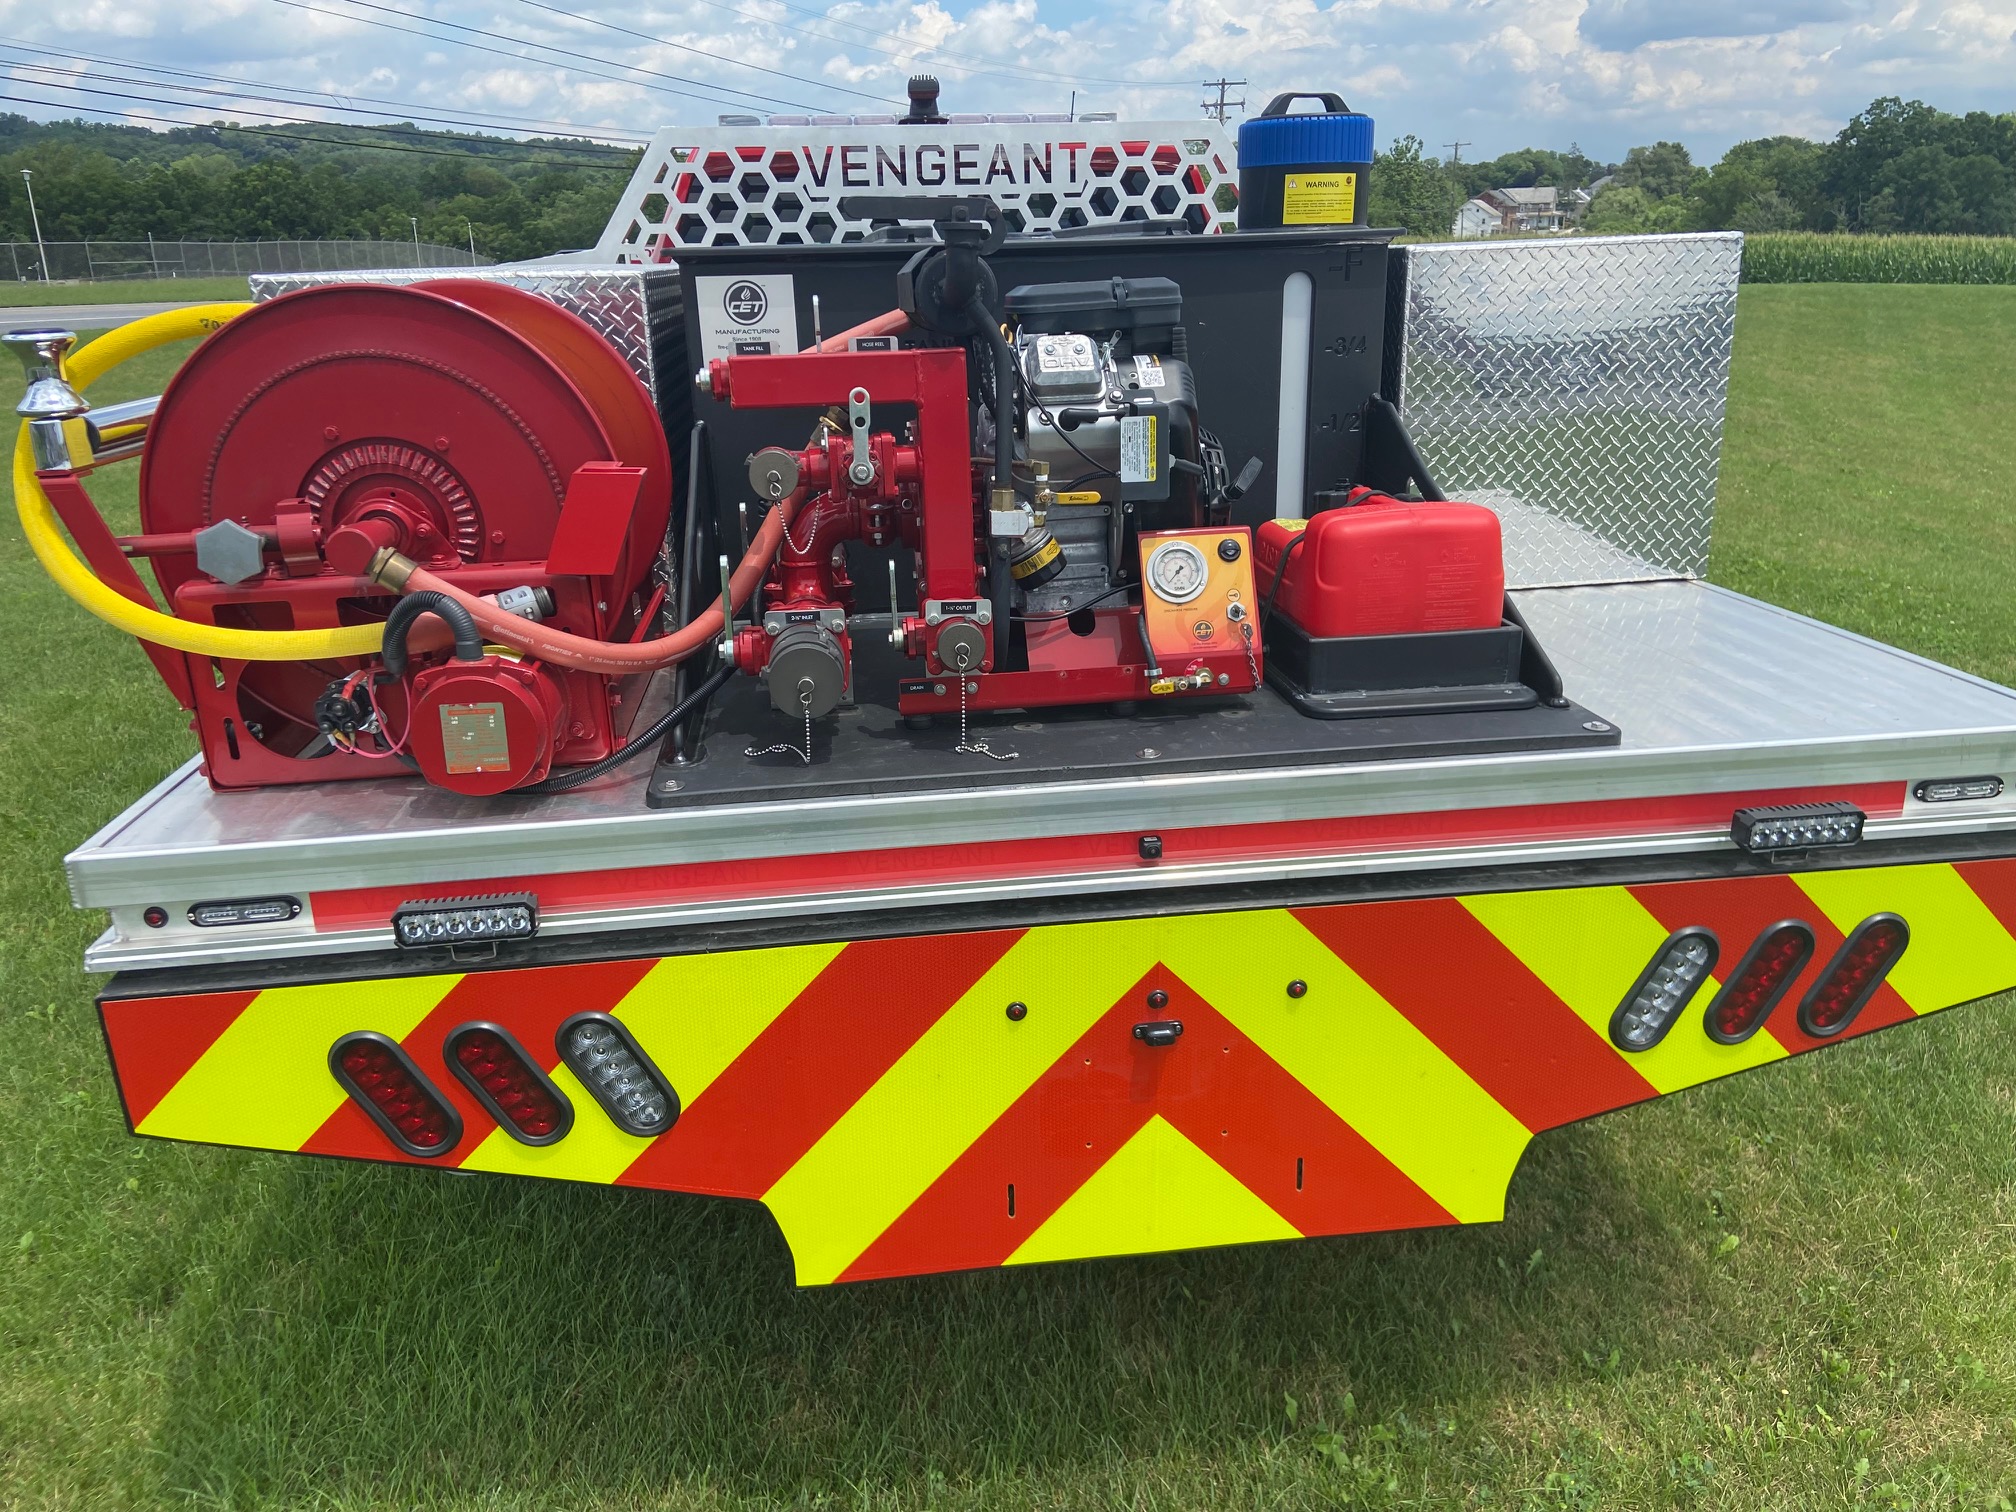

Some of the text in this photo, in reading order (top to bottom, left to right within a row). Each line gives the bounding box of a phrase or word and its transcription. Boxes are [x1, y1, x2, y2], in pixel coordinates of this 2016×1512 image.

[801, 141, 1088, 188] VENGEANT
[730, 301, 763, 313] CET
[1044, 357, 1090, 368] OHV
[492, 624, 530, 644] Continental
[541, 643, 573, 657] FRONTIER
[1088, 829, 1222, 855] VENANT
